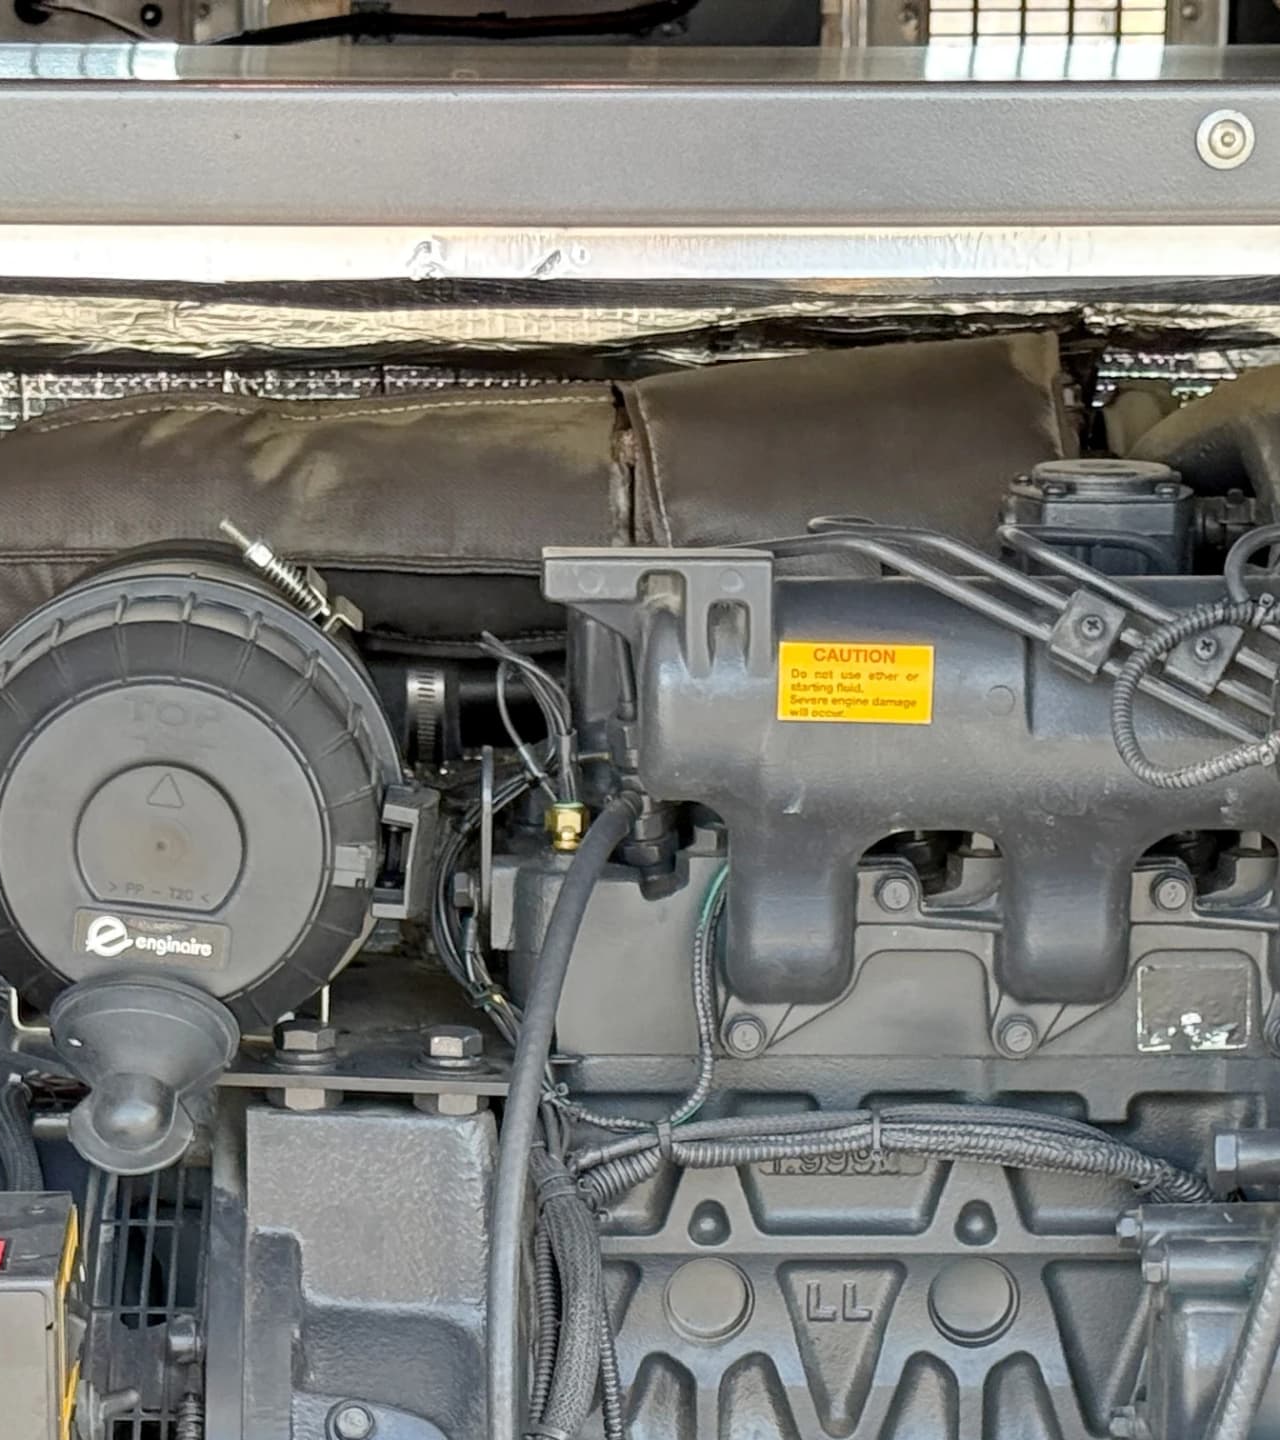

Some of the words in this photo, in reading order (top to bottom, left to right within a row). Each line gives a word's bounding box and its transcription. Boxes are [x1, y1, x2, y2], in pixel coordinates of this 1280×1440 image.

[813, 648, 896, 664] CAUTION
[791, 669, 807, 679] Do
[815, 671, 833, 680] not
[841, 672, 861, 680] use
[869, 671, 898, 681] ether
[906, 673, 919, 681] or
[791, 683, 833, 694] starting
[790, 695, 828, 705] Severe
[832, 697, 869, 707] engine
[872, 696, 917, 708] damage
[790, 708, 809, 716] will
[135, 935, 213, 956] enginaire
